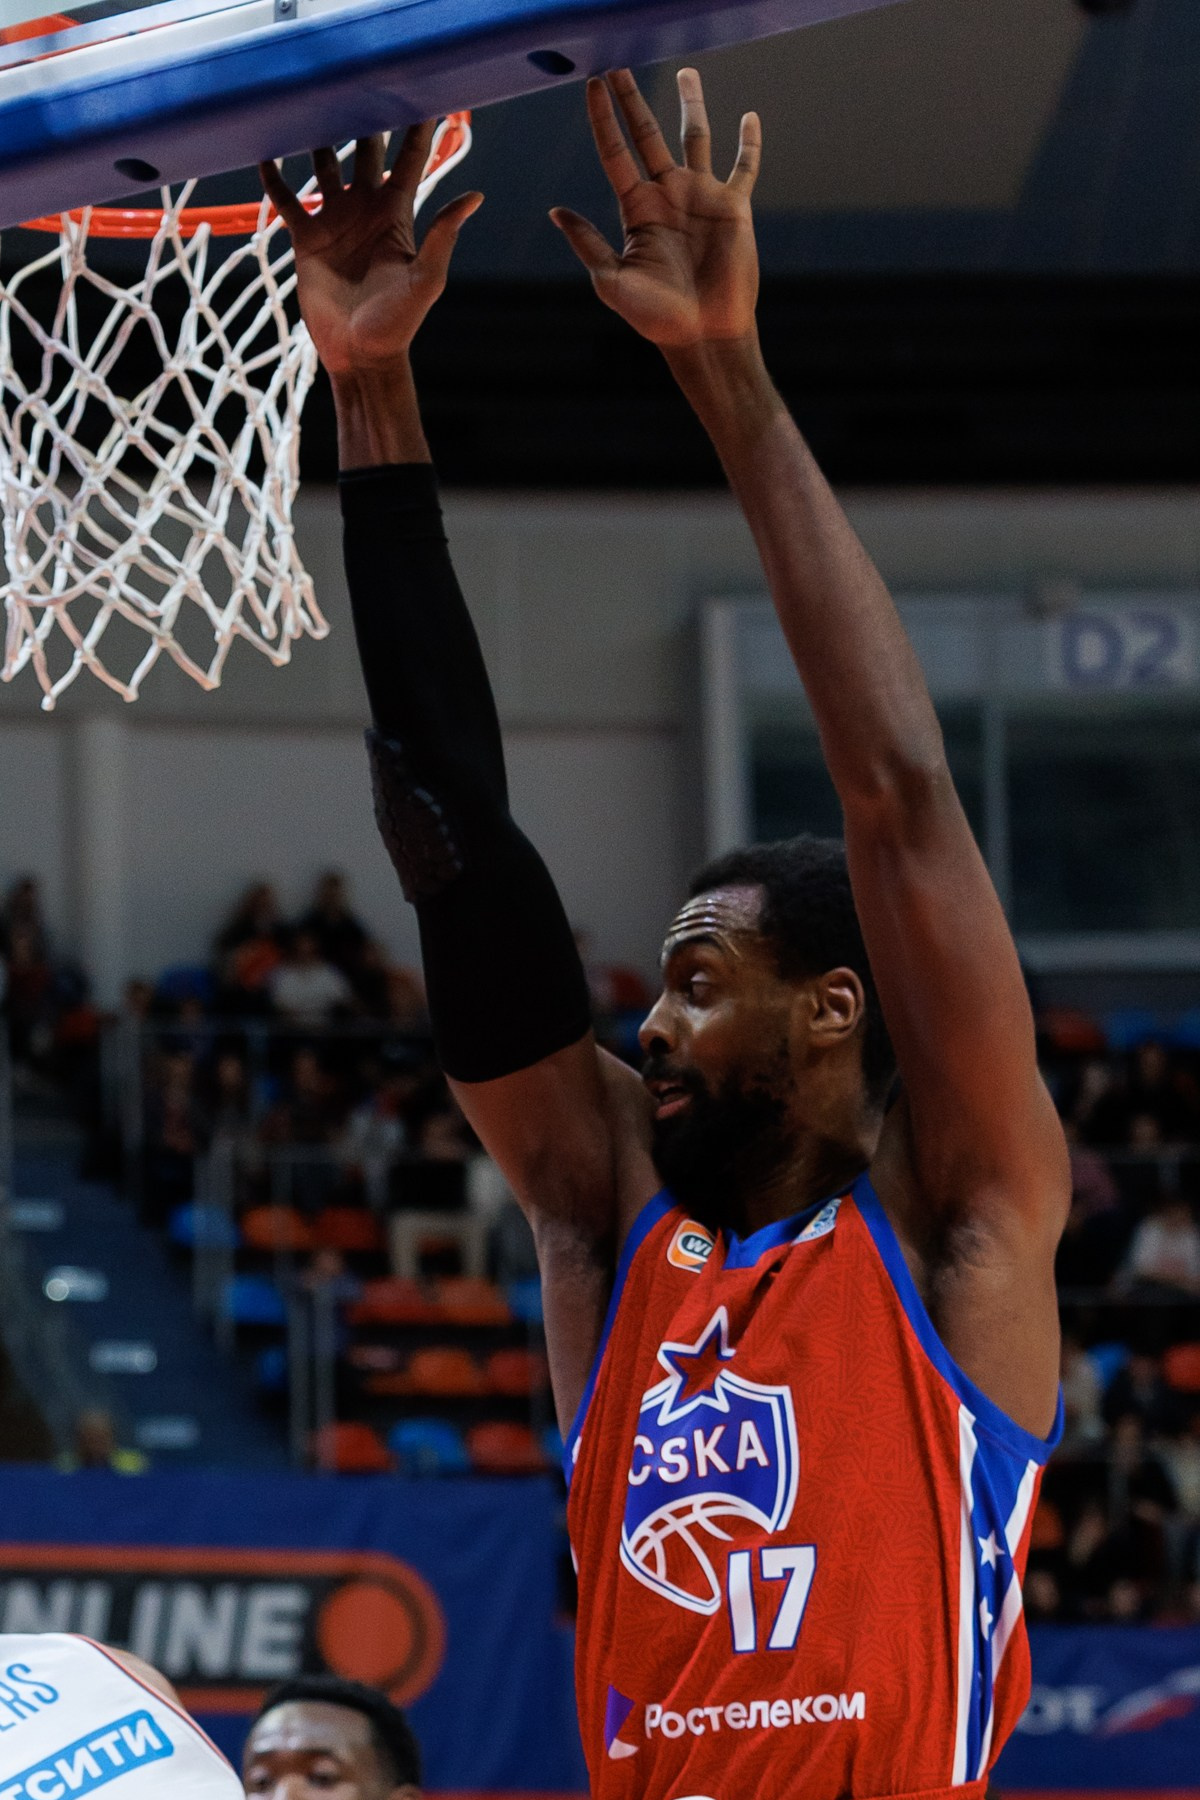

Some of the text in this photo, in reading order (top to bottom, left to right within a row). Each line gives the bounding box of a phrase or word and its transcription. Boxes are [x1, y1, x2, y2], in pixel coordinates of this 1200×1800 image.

[1060, 612, 1180, 688] D2
[628, 1420, 769, 1486] CSKA
[726, 1544, 817, 1654] 17
[644, 1691, 866, 1739] Ростелеком
